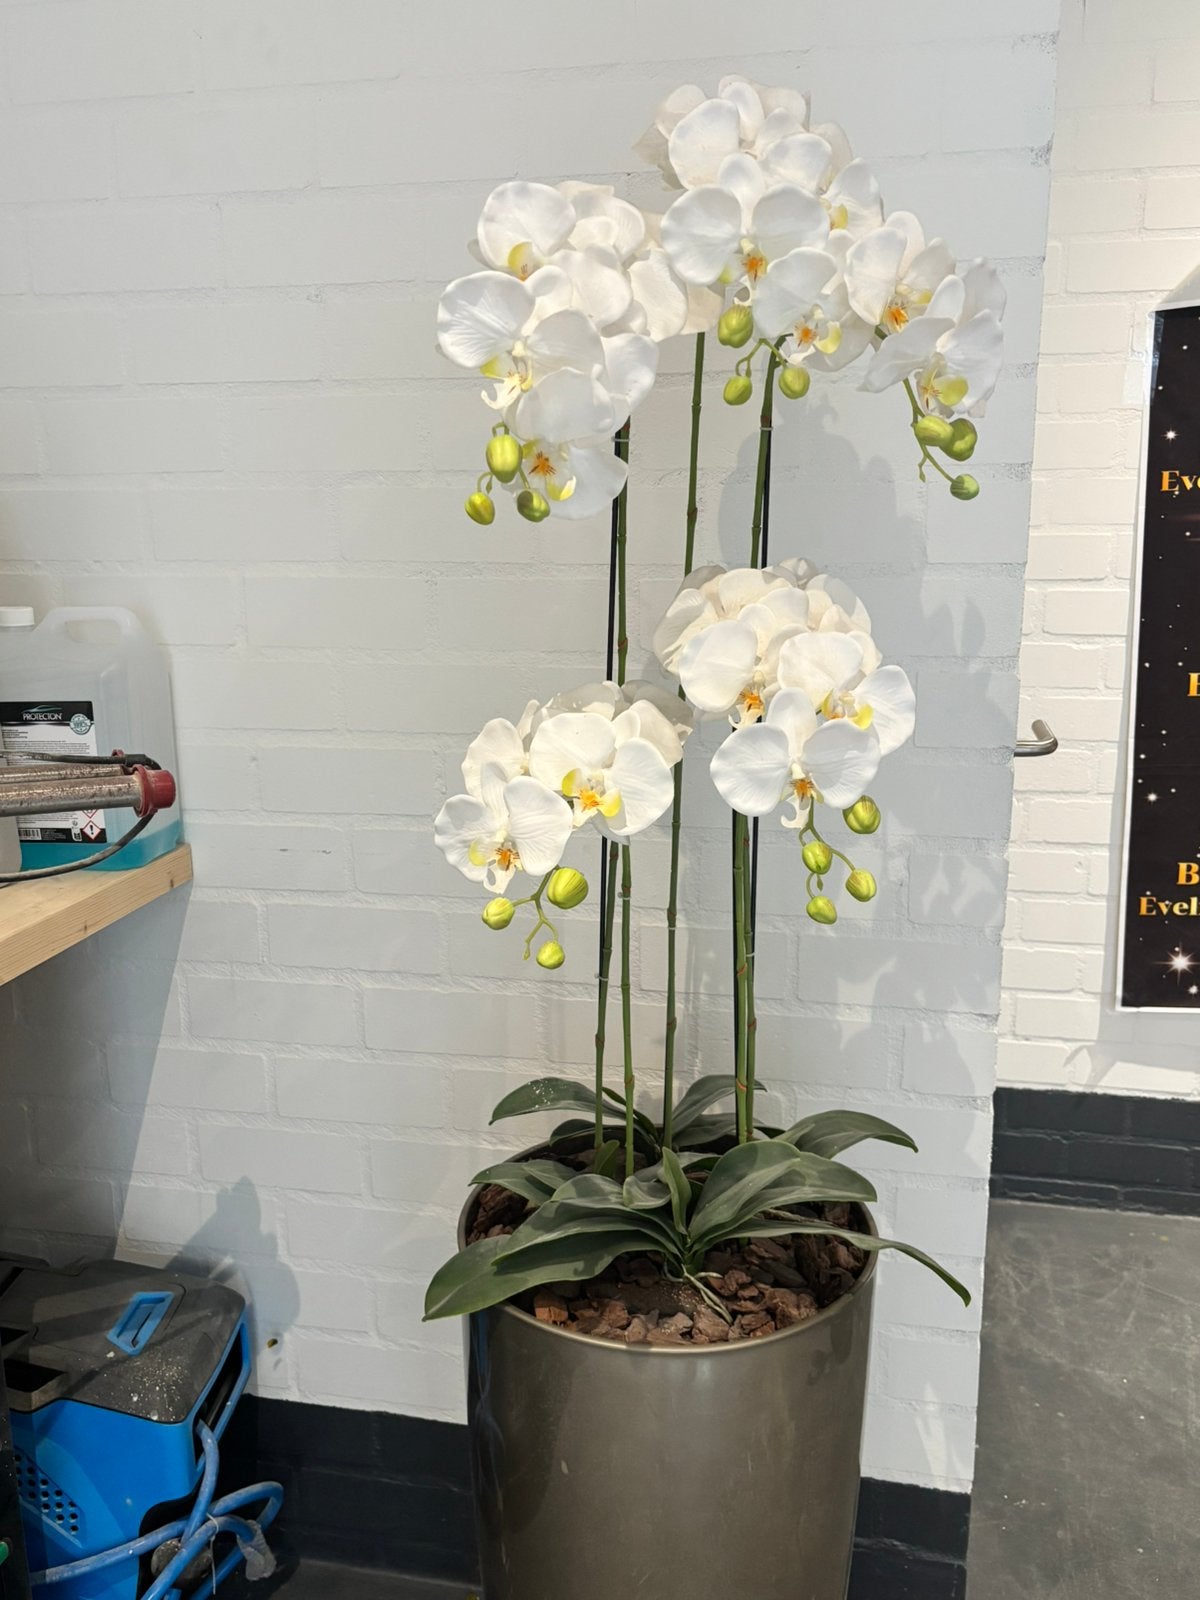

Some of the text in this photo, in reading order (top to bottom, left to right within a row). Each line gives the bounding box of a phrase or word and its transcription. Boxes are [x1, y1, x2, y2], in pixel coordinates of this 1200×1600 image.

[1160, 470, 1200, 491] Ev
[1176, 862, 1200, 886] B
[1139, 896, 1200, 916] Evel
